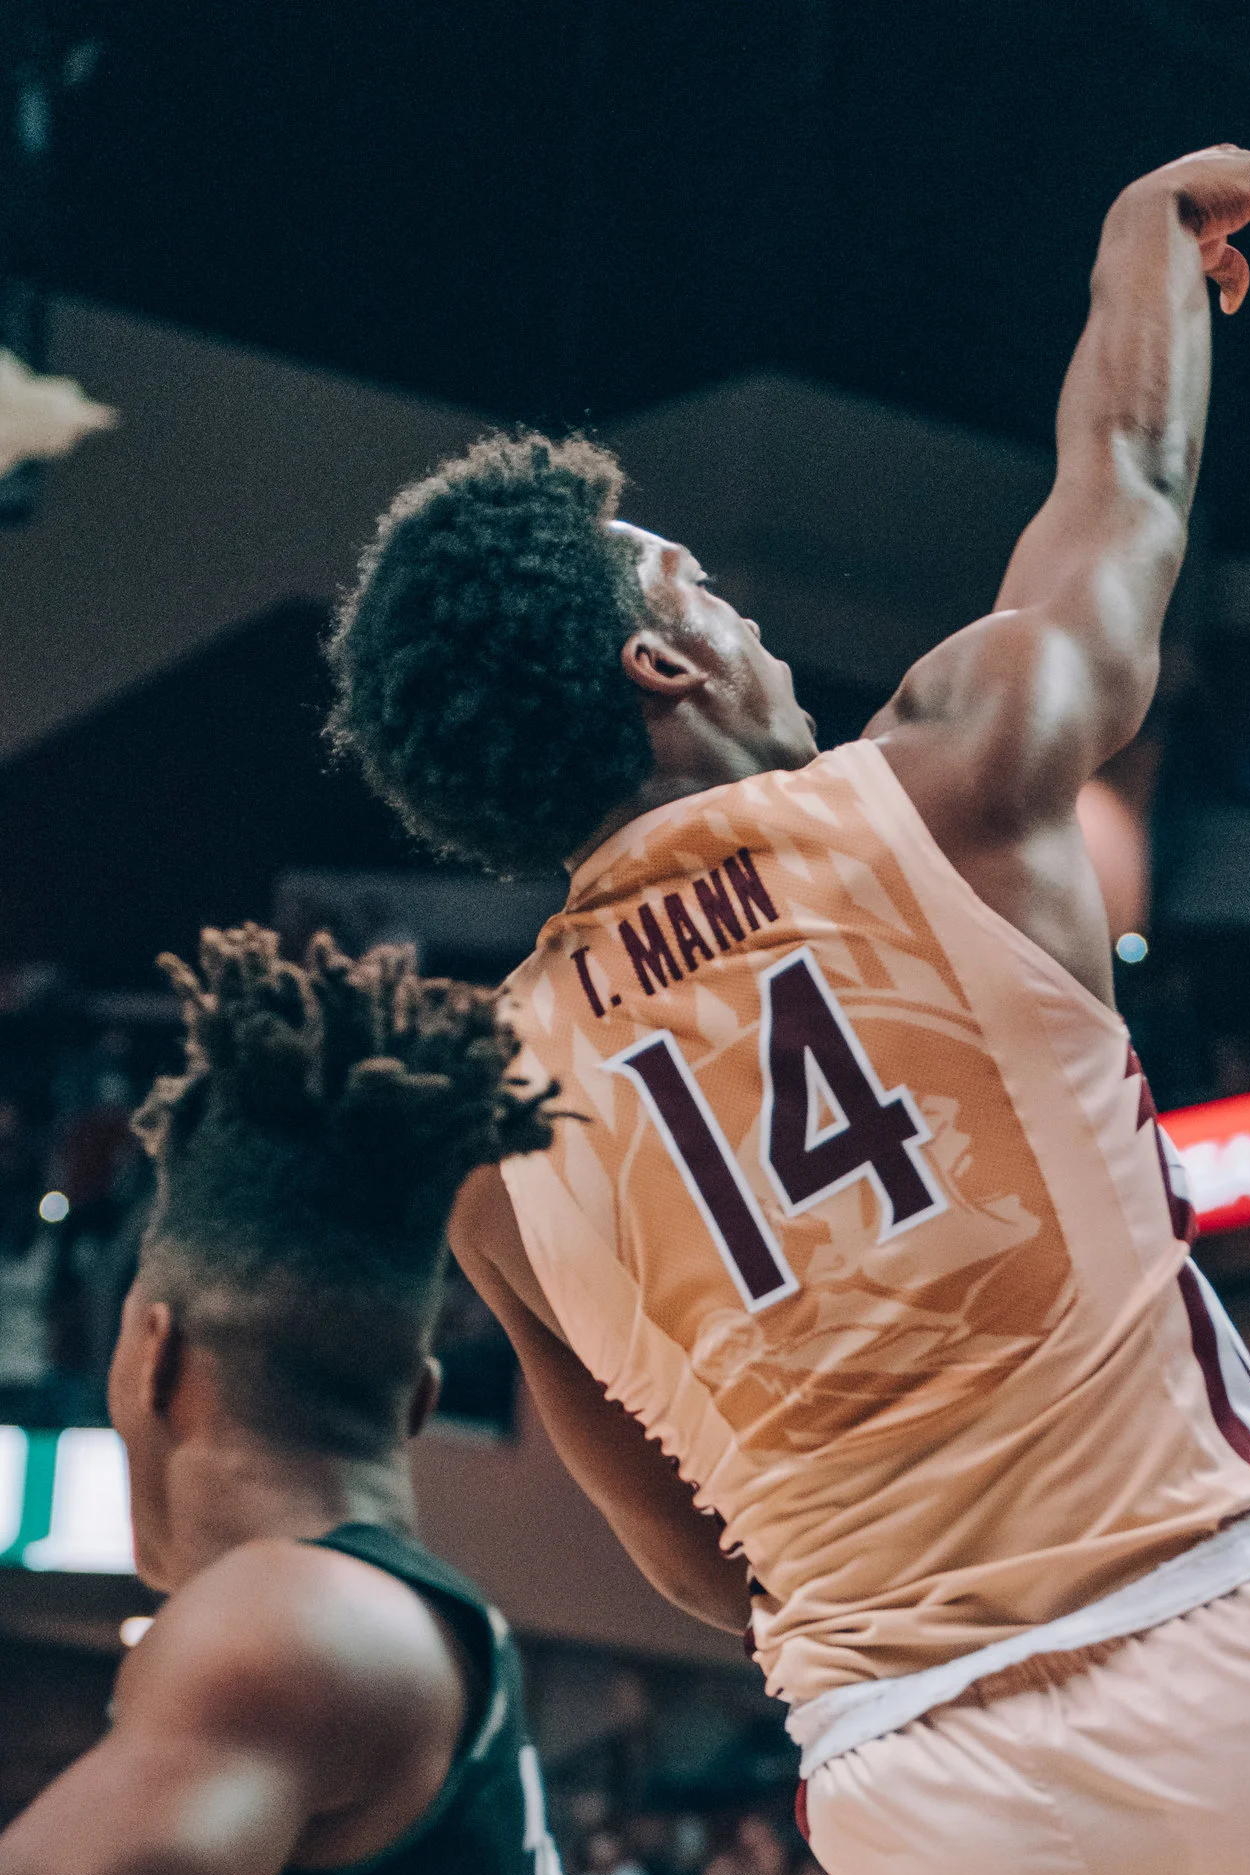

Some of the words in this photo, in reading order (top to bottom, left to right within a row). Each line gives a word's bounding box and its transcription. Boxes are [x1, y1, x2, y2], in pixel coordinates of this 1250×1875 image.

[570, 945, 622, 1018] T.
[618, 847, 778, 996] MANN
[597, 943, 949, 1313] 14
